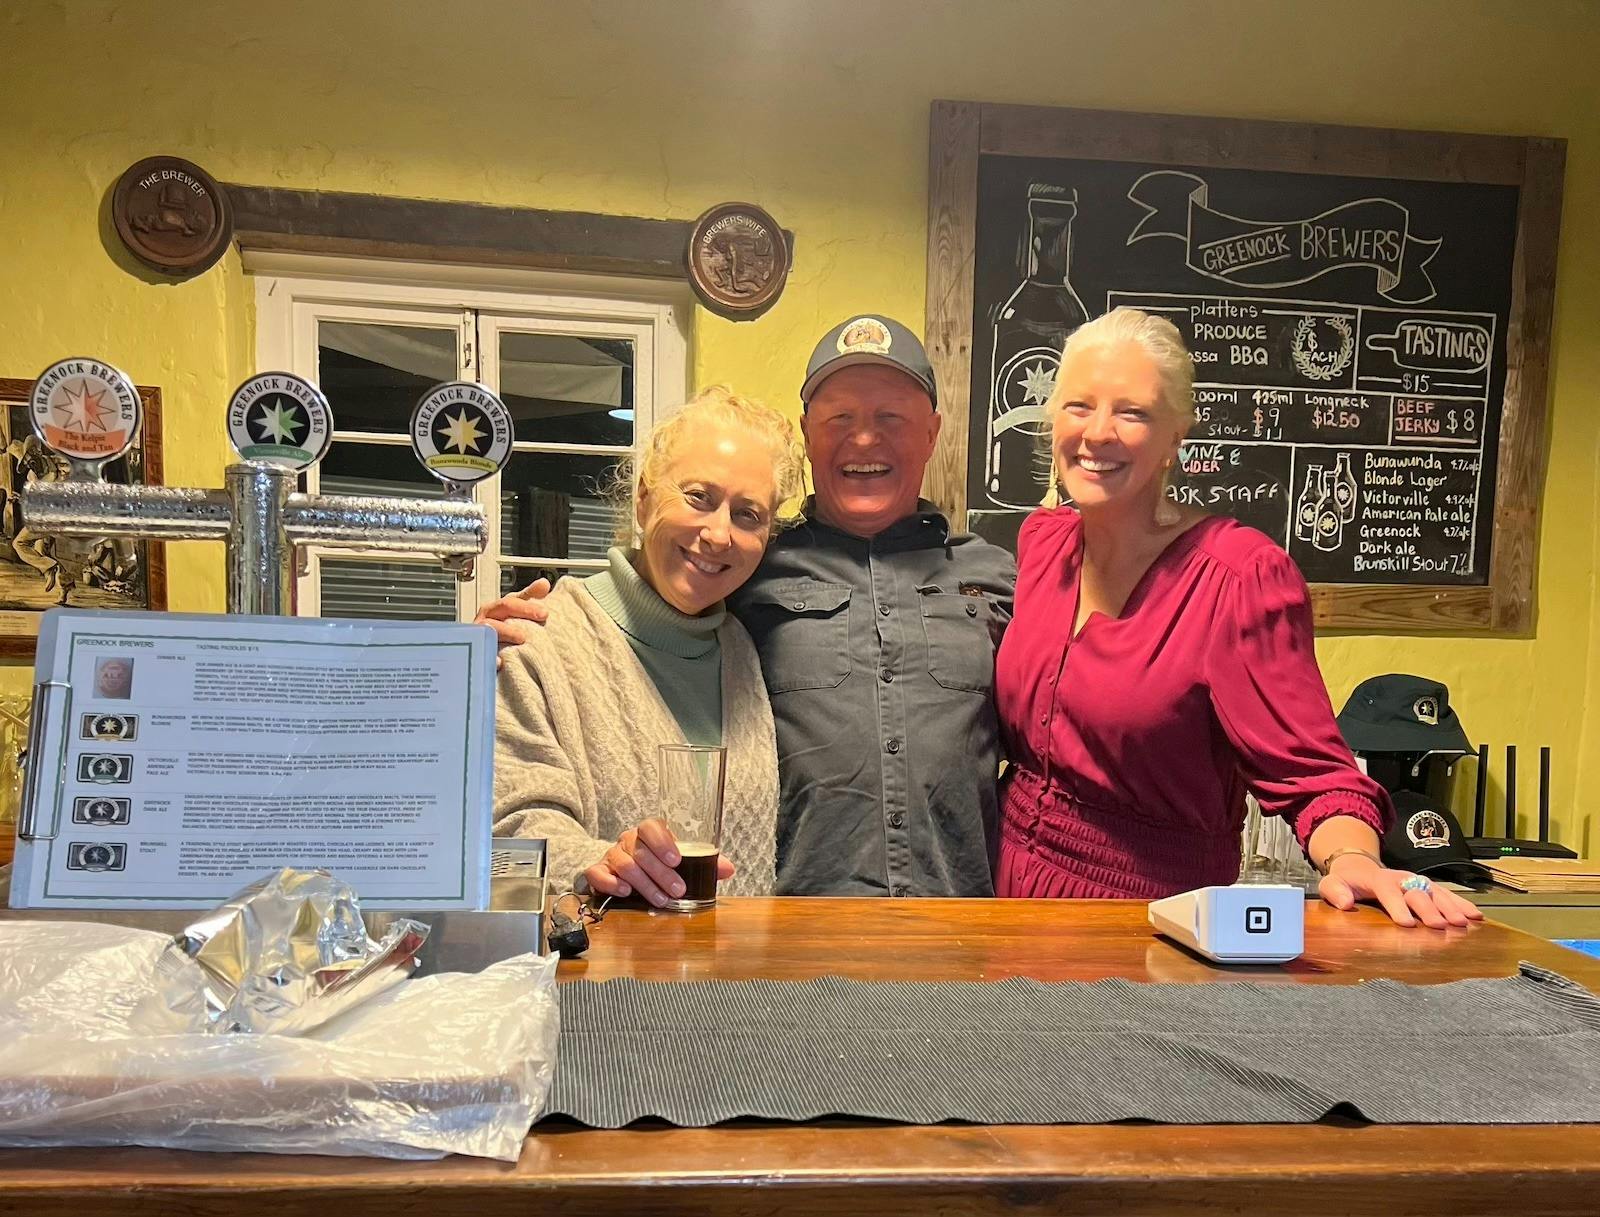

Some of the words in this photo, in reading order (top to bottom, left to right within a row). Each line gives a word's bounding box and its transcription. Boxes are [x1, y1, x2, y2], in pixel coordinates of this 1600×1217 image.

[139, 172, 160, 190] THE
[161, 170, 206, 197] BREWER
[702, 215, 743, 244] BREWERS
[745, 218, 767, 237] WIFE
[1203, 233, 1290, 270] GREENOCK
[1301, 222, 1400, 262] BREWERS
[1191, 300, 1259, 322] platters
[1194, 323, 1267, 341] PRODUCE
[1230, 344, 1269, 365] BBQ
[1401, 325, 1486, 364] TASTINGS
[1302, 351, 1338, 363] EACH
[36, 363, 84, 414] GREENOCK
[91, 364, 133, 421] BREWERS
[1402, 373, 1431, 393] $15
[233, 379, 280, 427] GREENOCK
[285, 380, 324, 434] BREWERS
[1251, 390, 1293, 406] 425ml
[1305, 394, 1370, 412] Longneck
[1397, 399, 1436, 414] BEEF
[418, 388, 464, 437] GREENOCK
[469, 390, 507, 444] BREWERS
[1311, 406, 1361, 429] $12.50
[1394, 417, 1440, 434] JERKY
[1178, 443, 1225, 462] WINE
[1364, 452, 1442, 470] Bunawunda
[1182, 460, 1221, 474] CIDER
[1364, 469, 1404, 486] Blonde
[1410, 471, 1447, 492] Lager
[1167, 485, 1205, 506] ASK
[1208, 482, 1280, 504] STAFF
[1363, 489, 1430, 506] Victorville
[1362, 507, 1421, 521] American
[1425, 507, 1448, 522] Pale
[1450, 505, 1471, 523] ale
[1360, 523, 1421, 538] Greenock
[1360, 541, 1392, 555] Dark
[1395, 541, 1416, 555] ale
[1354, 555, 1409, 572] Brunskill
[1412, 556, 1448, 571] Stout
[76, 638, 117, 647] GREENOCK
[119, 640, 154, 648] BREWERS
